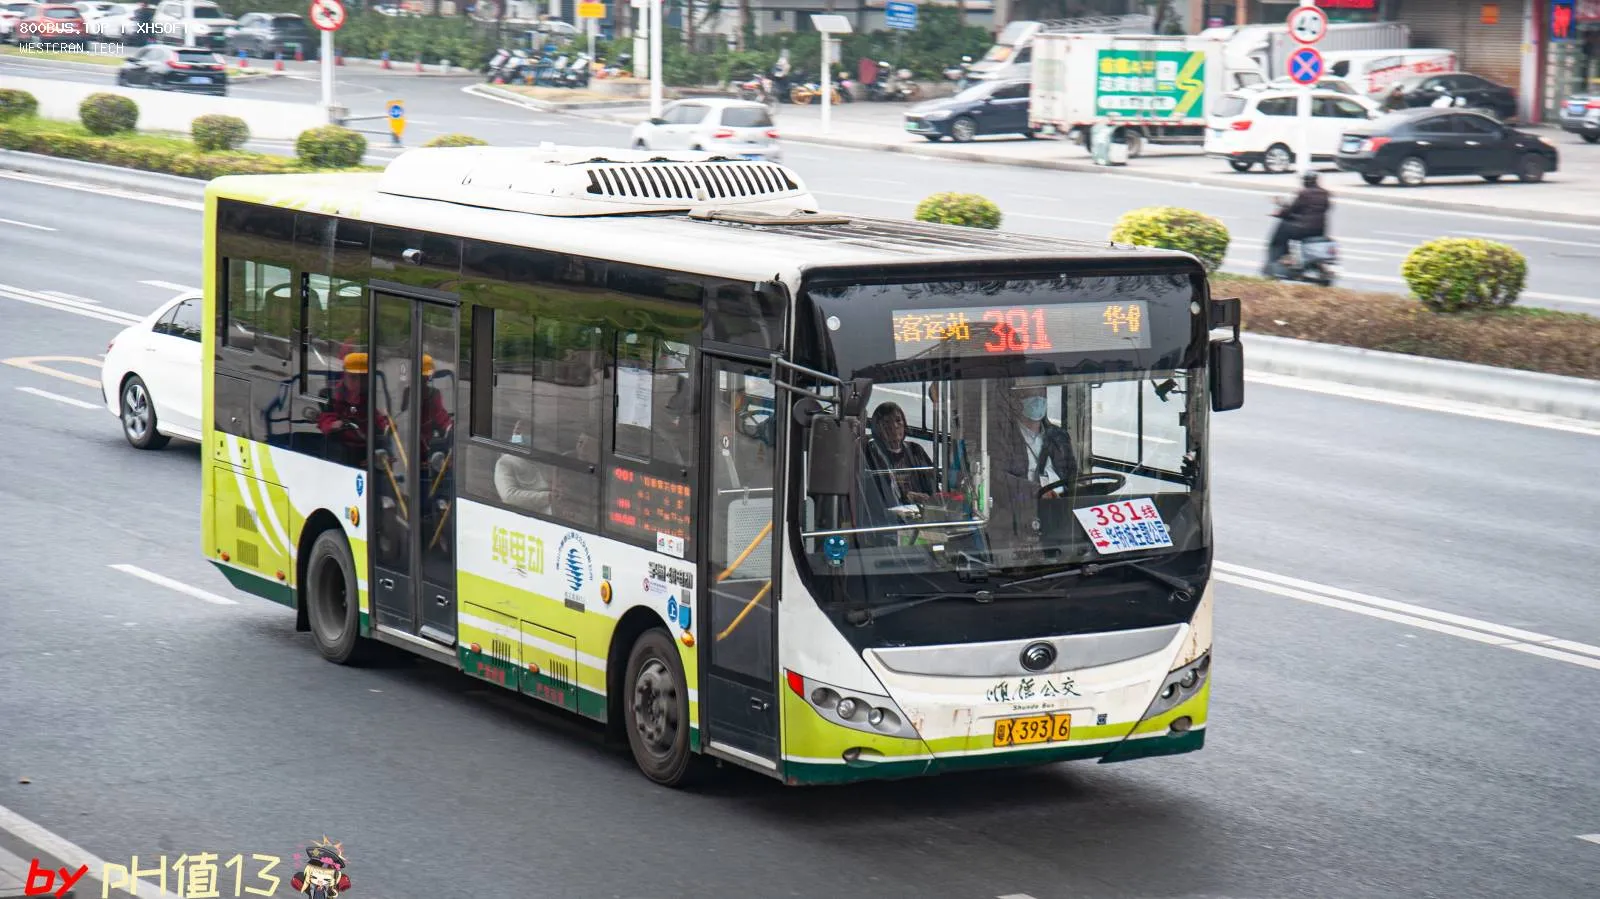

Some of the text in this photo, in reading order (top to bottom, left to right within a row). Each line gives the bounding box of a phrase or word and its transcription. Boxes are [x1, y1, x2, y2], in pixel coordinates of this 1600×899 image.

[982, 308, 1052, 352] 381
[492, 525, 544, 574] 纯电动
